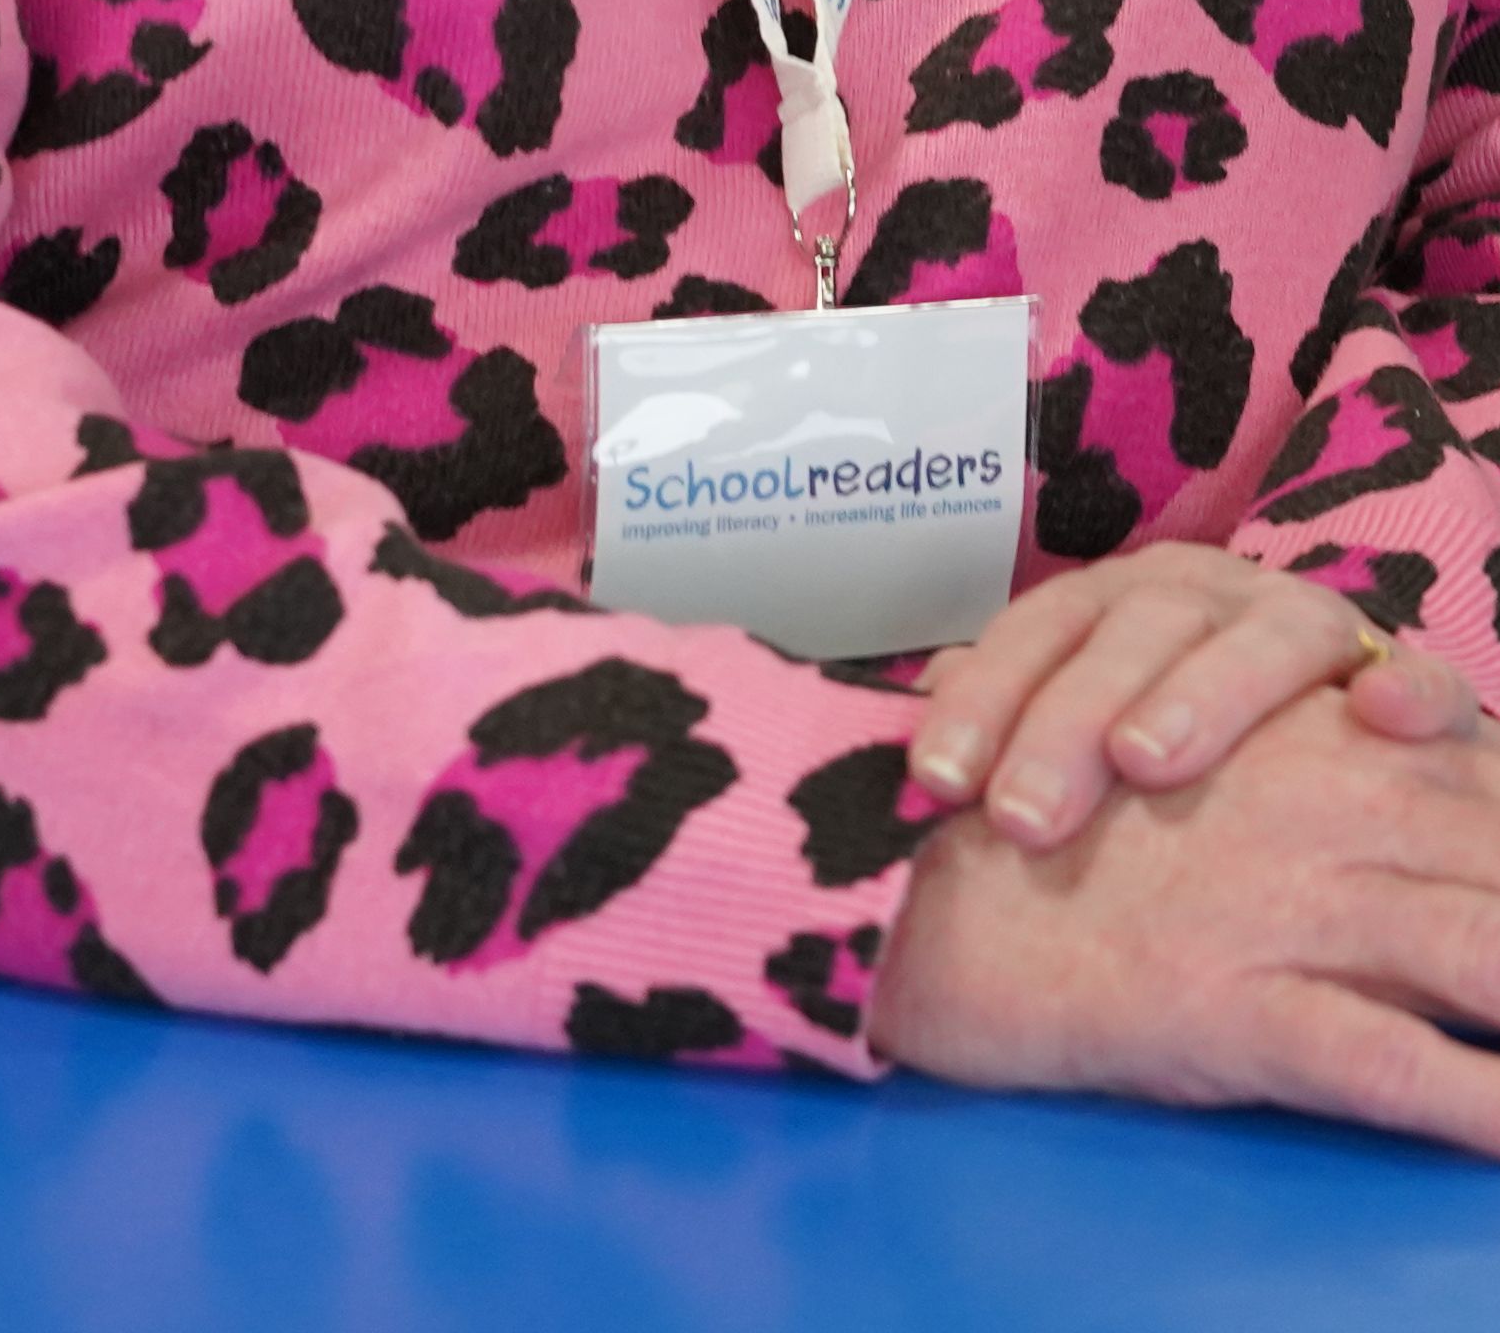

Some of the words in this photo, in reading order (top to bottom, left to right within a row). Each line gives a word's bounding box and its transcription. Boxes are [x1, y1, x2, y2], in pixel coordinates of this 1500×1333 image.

[623, 446, 1003, 512] Schoolreaders
[621, 514, 712, 542] improving
[716, 511, 780, 534] literacy
[804, 505, 897, 528] increasing
[900, 500, 928, 520] life
[931, 494, 1003, 517] chances
